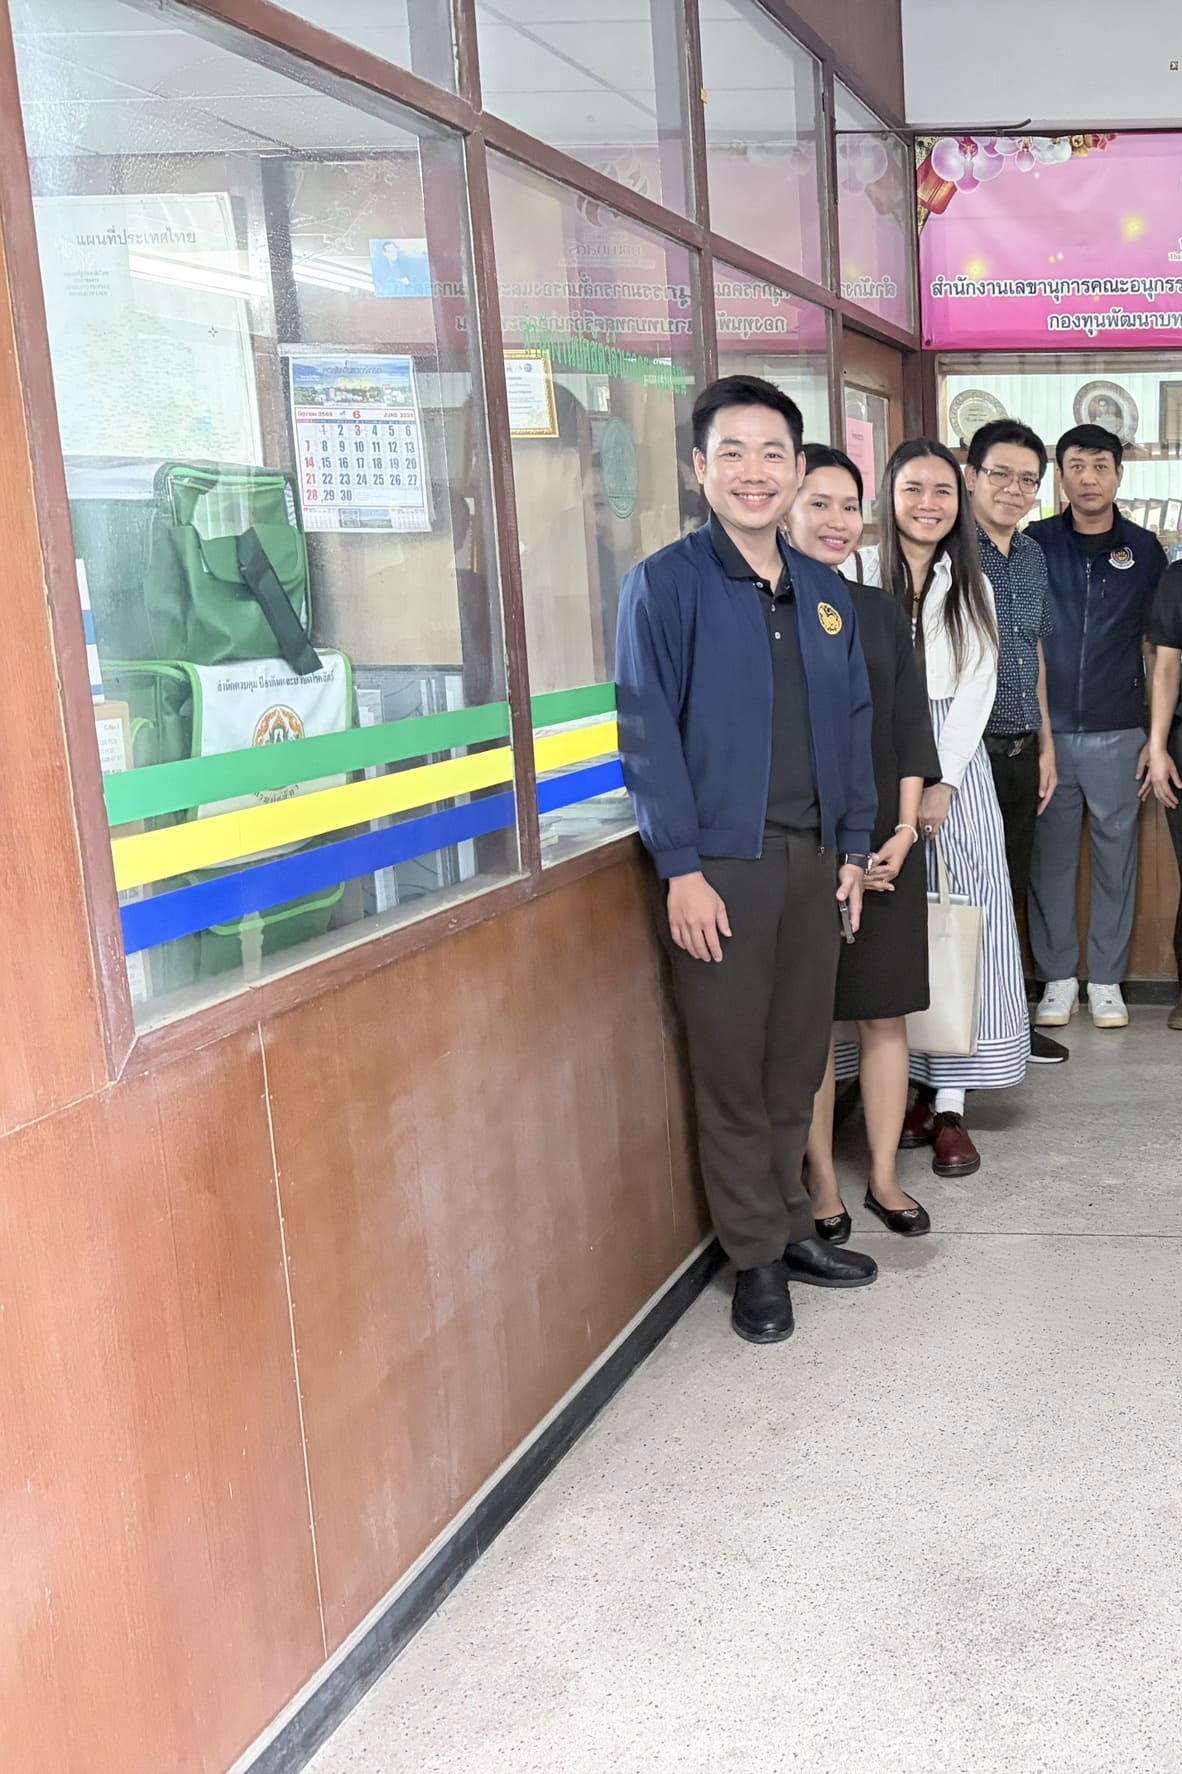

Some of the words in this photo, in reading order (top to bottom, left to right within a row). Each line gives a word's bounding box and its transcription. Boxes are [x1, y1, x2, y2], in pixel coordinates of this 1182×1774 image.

[76, 225, 197, 247] แผนที่ประเทศไทย
[352, 410, 361, 419] 6
[322, 425, 327, 435] 1
[338, 425, 344, 436] 2
[355, 425, 361, 436] 3
[372, 425, 378, 436] 4
[388, 425, 395, 436] 5
[405, 426, 412, 436] 6
[305, 440, 310, 451] 7
[322, 440, 328, 451] 8
[339, 441, 345, 452] 9
[354, 441, 364, 452] 10
[372, 441, 381, 452] 11
[388, 441, 398, 453] 12
[405, 442, 415, 453] 13
[304, 457, 315, 468] 14
[321, 457, 332, 468] 15
[338, 457, 349, 468] 16
[356, 458, 365, 469] 17
[372, 458, 383, 469] 18
[389, 458, 400, 469] 19
[405, 458, 417, 469] 20
[306, 474, 316, 485] 21
[322, 474, 333, 485] 22
[339, 474, 351, 485] 23
[356, 474, 367, 485] 24
[373, 474, 384, 485] 25
[390, 474, 401, 486] 26
[407, 474, 418, 486] 27
[306, 489, 318, 501] 28
[323, 489, 335, 501] 29
[340, 489, 352, 501] 30
